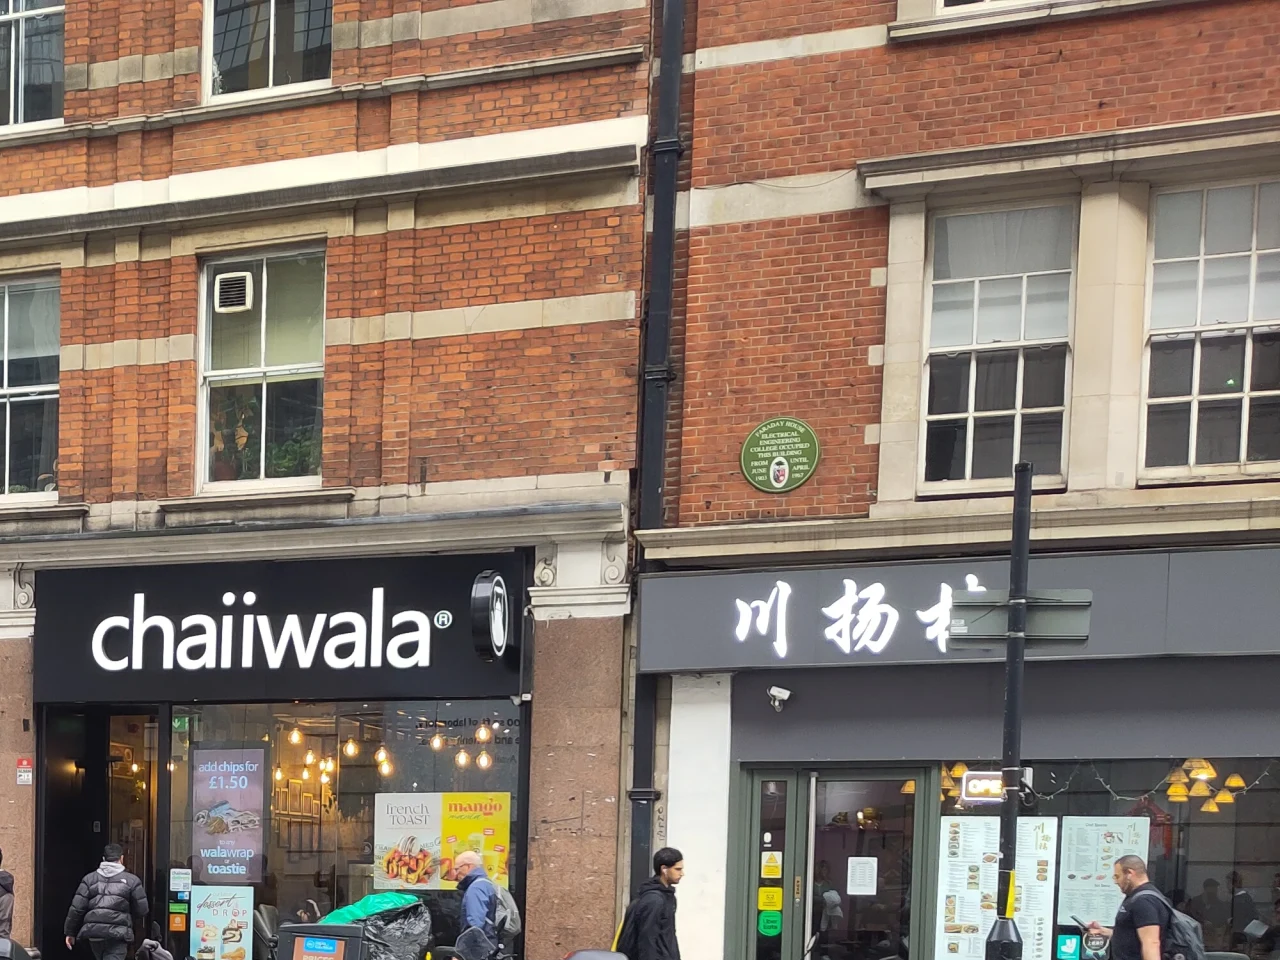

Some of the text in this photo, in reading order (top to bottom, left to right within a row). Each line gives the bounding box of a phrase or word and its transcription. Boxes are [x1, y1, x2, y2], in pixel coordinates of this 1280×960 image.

[755, 421, 806, 437] FARADAY HOUSE
[761, 431, 799, 439] ELECTRICAL
[759, 437, 801, 445] ENGINEERING
[750, 445, 778, 453] COLLEGE
[198, 761, 258, 774] add chips for
[209, 776, 248, 789] £1.50
[968, 779, 1003, 794] OPE
[386, 803, 429, 814] french
[448, 800, 503, 815] mango
[389, 815, 430, 825] TOAST
[200, 846, 254, 860] walawrap
[207, 863, 247, 874] toastie
